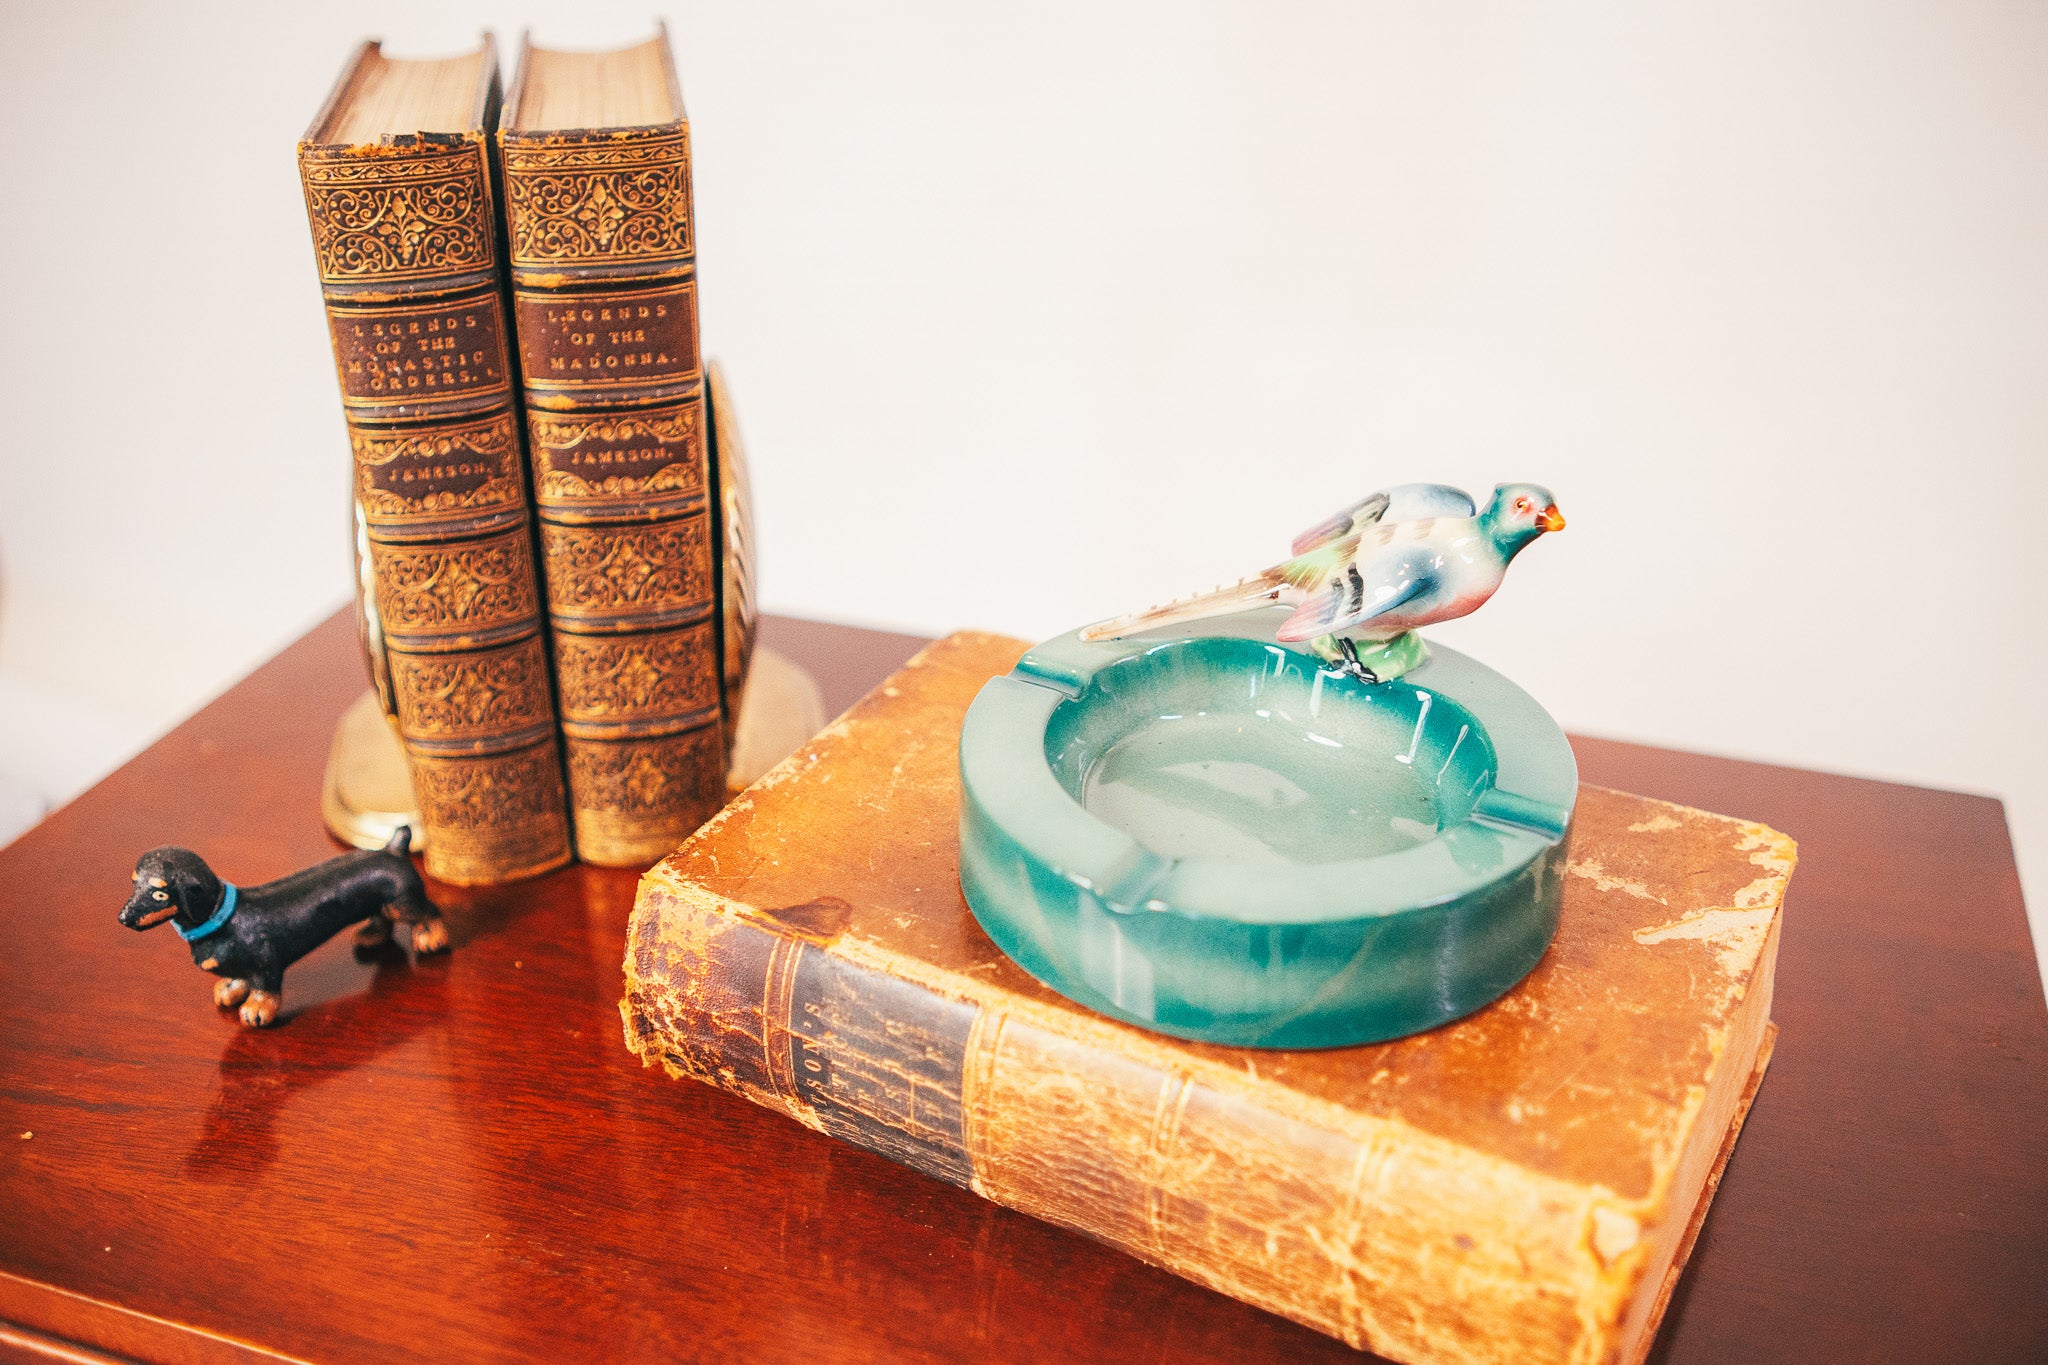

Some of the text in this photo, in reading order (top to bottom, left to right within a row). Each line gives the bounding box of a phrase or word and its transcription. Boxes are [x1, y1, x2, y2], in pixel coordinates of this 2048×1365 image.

[548, 304, 667, 323] LEGENDS
[354, 315, 477, 337] LEGENDS
[376, 336, 456, 354] OF THE
[570, 329, 645, 346] OF THE
[348, 351, 483, 374] MONASTIC
